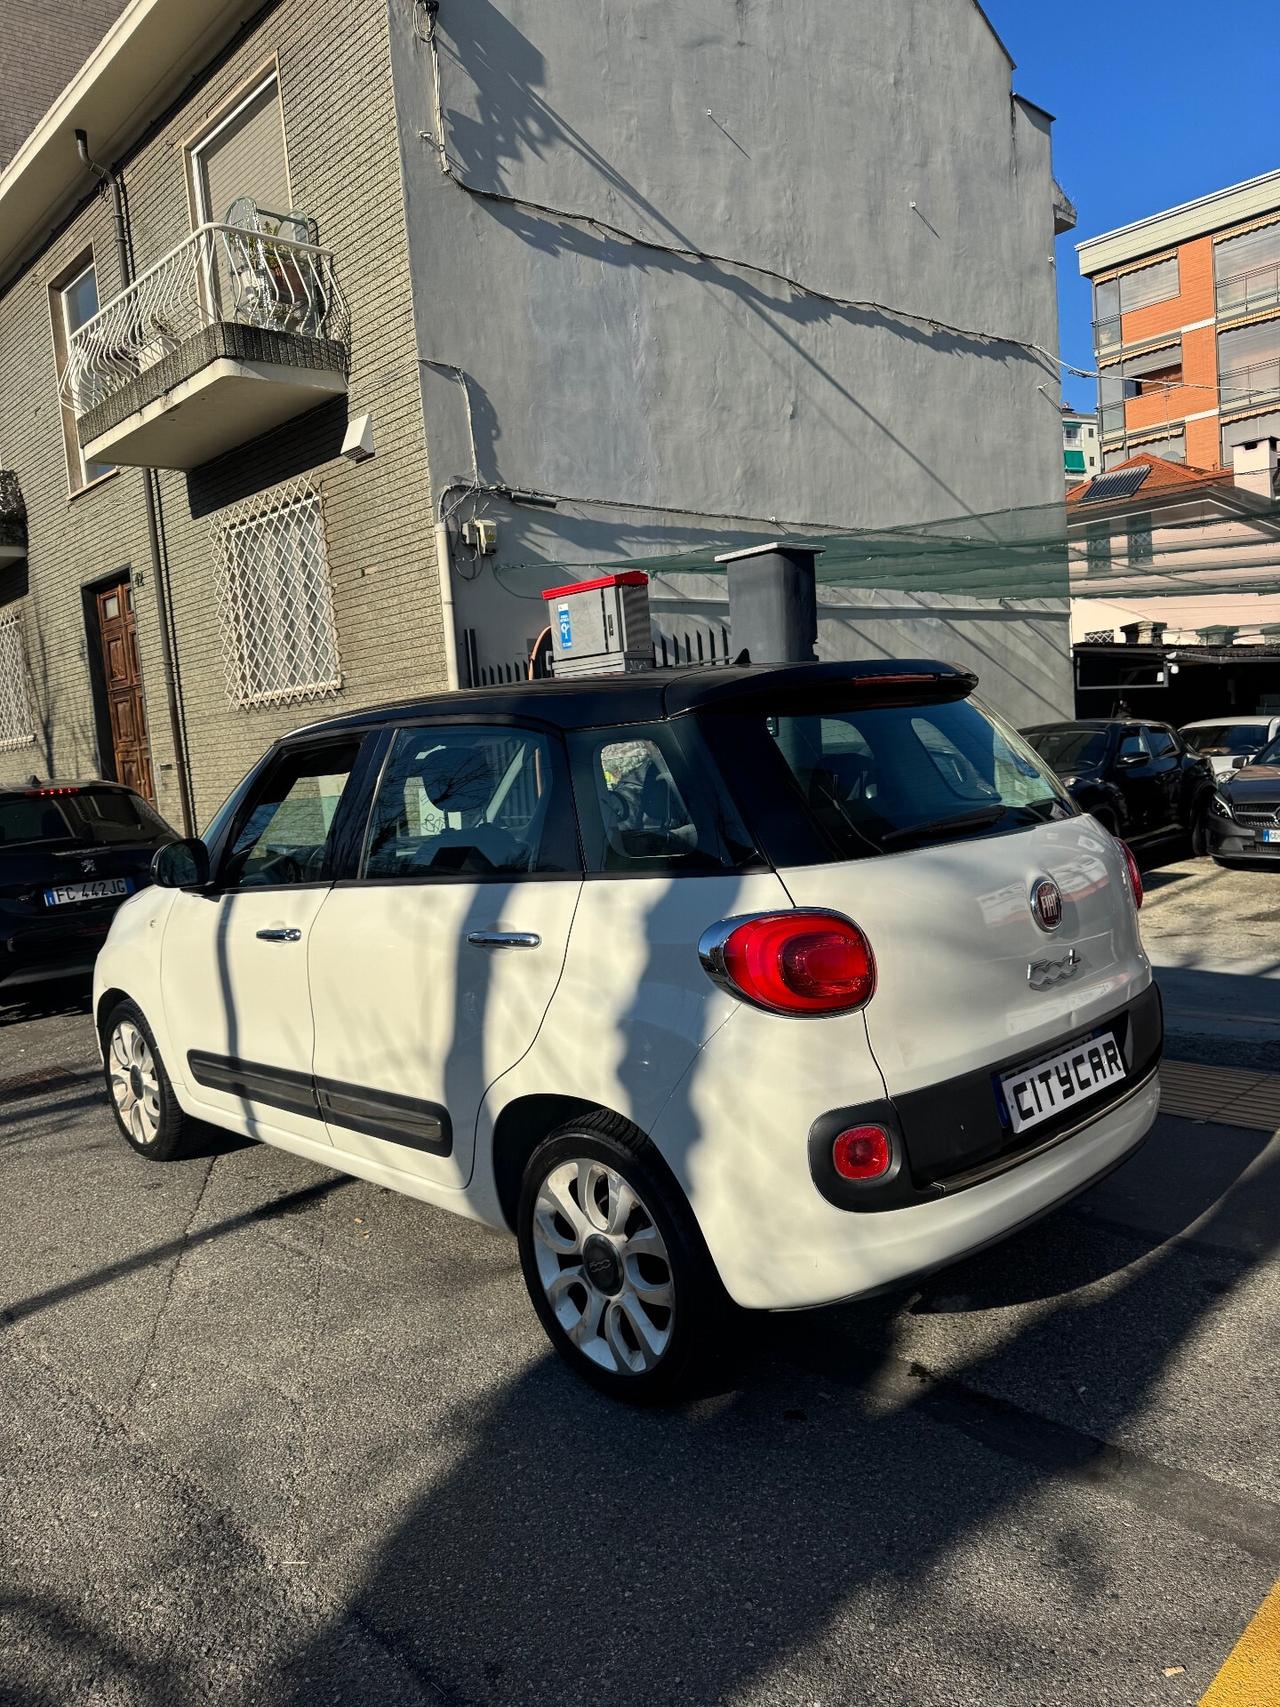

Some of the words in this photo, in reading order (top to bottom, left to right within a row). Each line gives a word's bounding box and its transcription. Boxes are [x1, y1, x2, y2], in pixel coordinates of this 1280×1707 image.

[56, 886, 76, 903] FC
[1040, 893, 1058, 918] FIAT
[1012, 1039, 1122, 1121] CITYCAR
